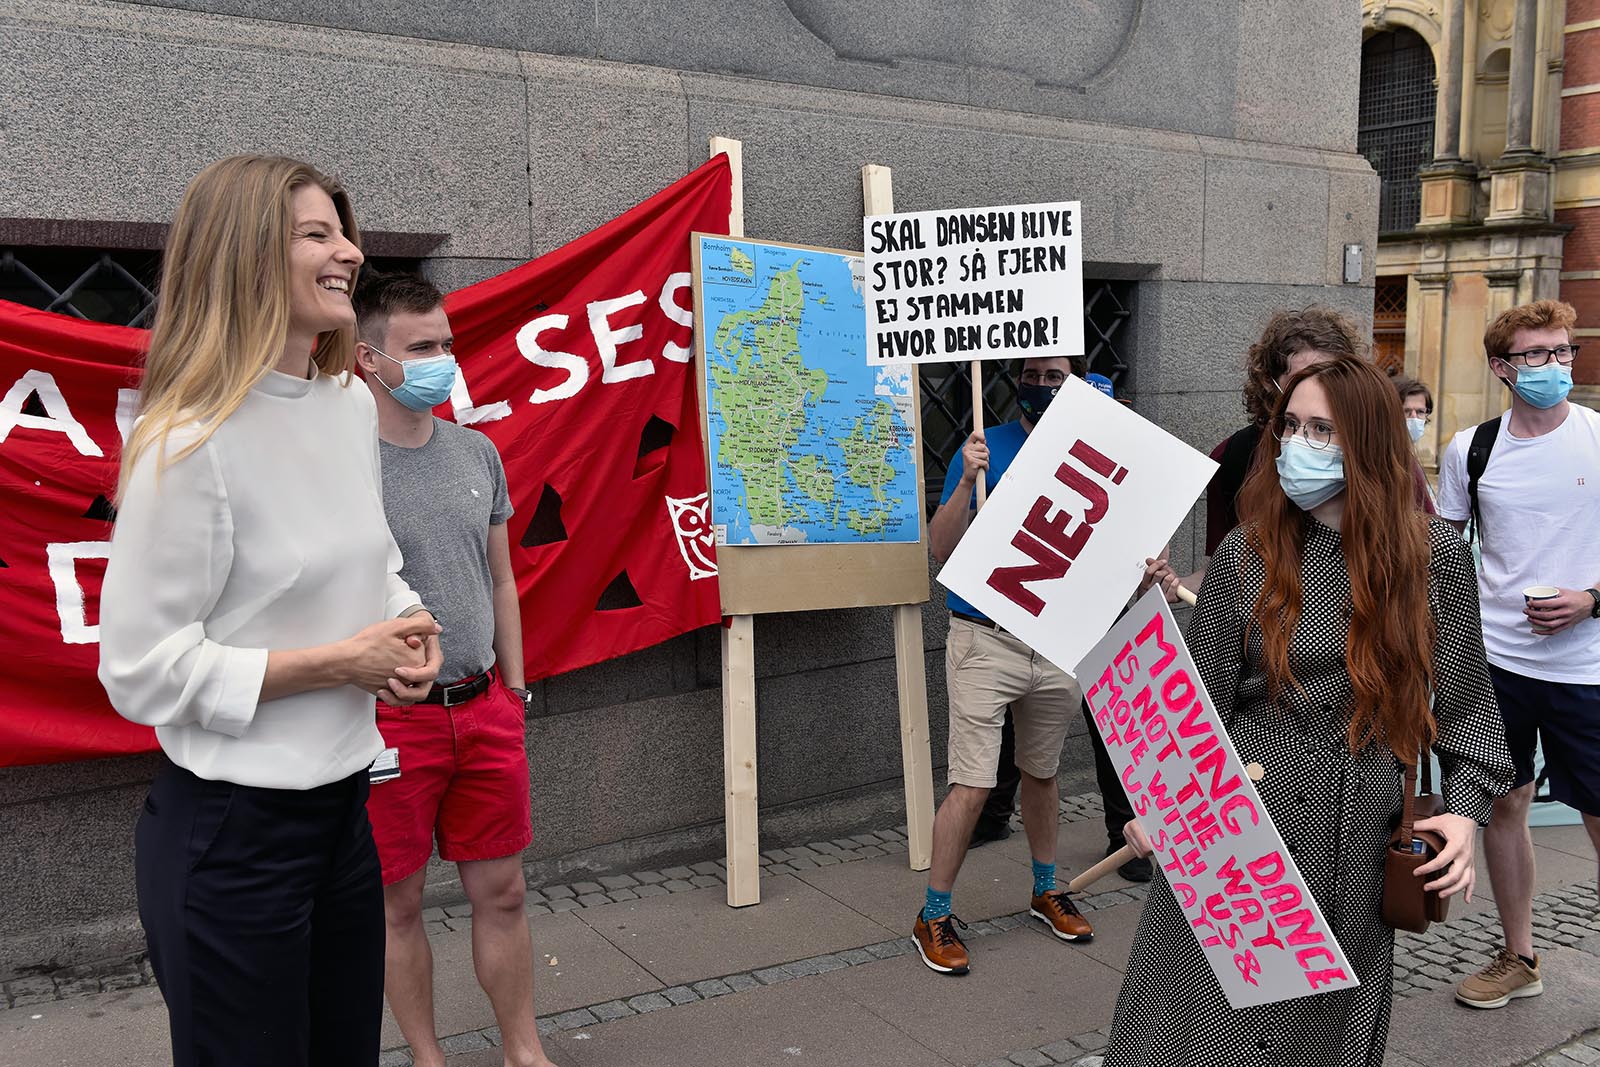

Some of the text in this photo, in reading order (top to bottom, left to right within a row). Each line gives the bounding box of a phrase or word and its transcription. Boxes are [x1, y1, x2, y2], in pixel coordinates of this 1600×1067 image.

[871, 210, 1072, 254] SKAL DANSEN BLIVE
[872, 245, 1066, 292] STOR? SÅ FJERN
[875, 288, 1024, 324] EJ STAMMEN
[877, 316, 1059, 358] HVOR DEN GROR!
[986, 439, 1129, 617] NEJ!
[1086, 683, 1222, 949] LET US STAY!
[1098, 664, 1150, 767] MOVE
[1147, 769, 1208, 878] WITH
[1205, 892, 1245, 951] US
[1113, 641, 1285, 950] IS NOT THE WAY
[1135, 612, 1348, 990] MOVING DANCE
